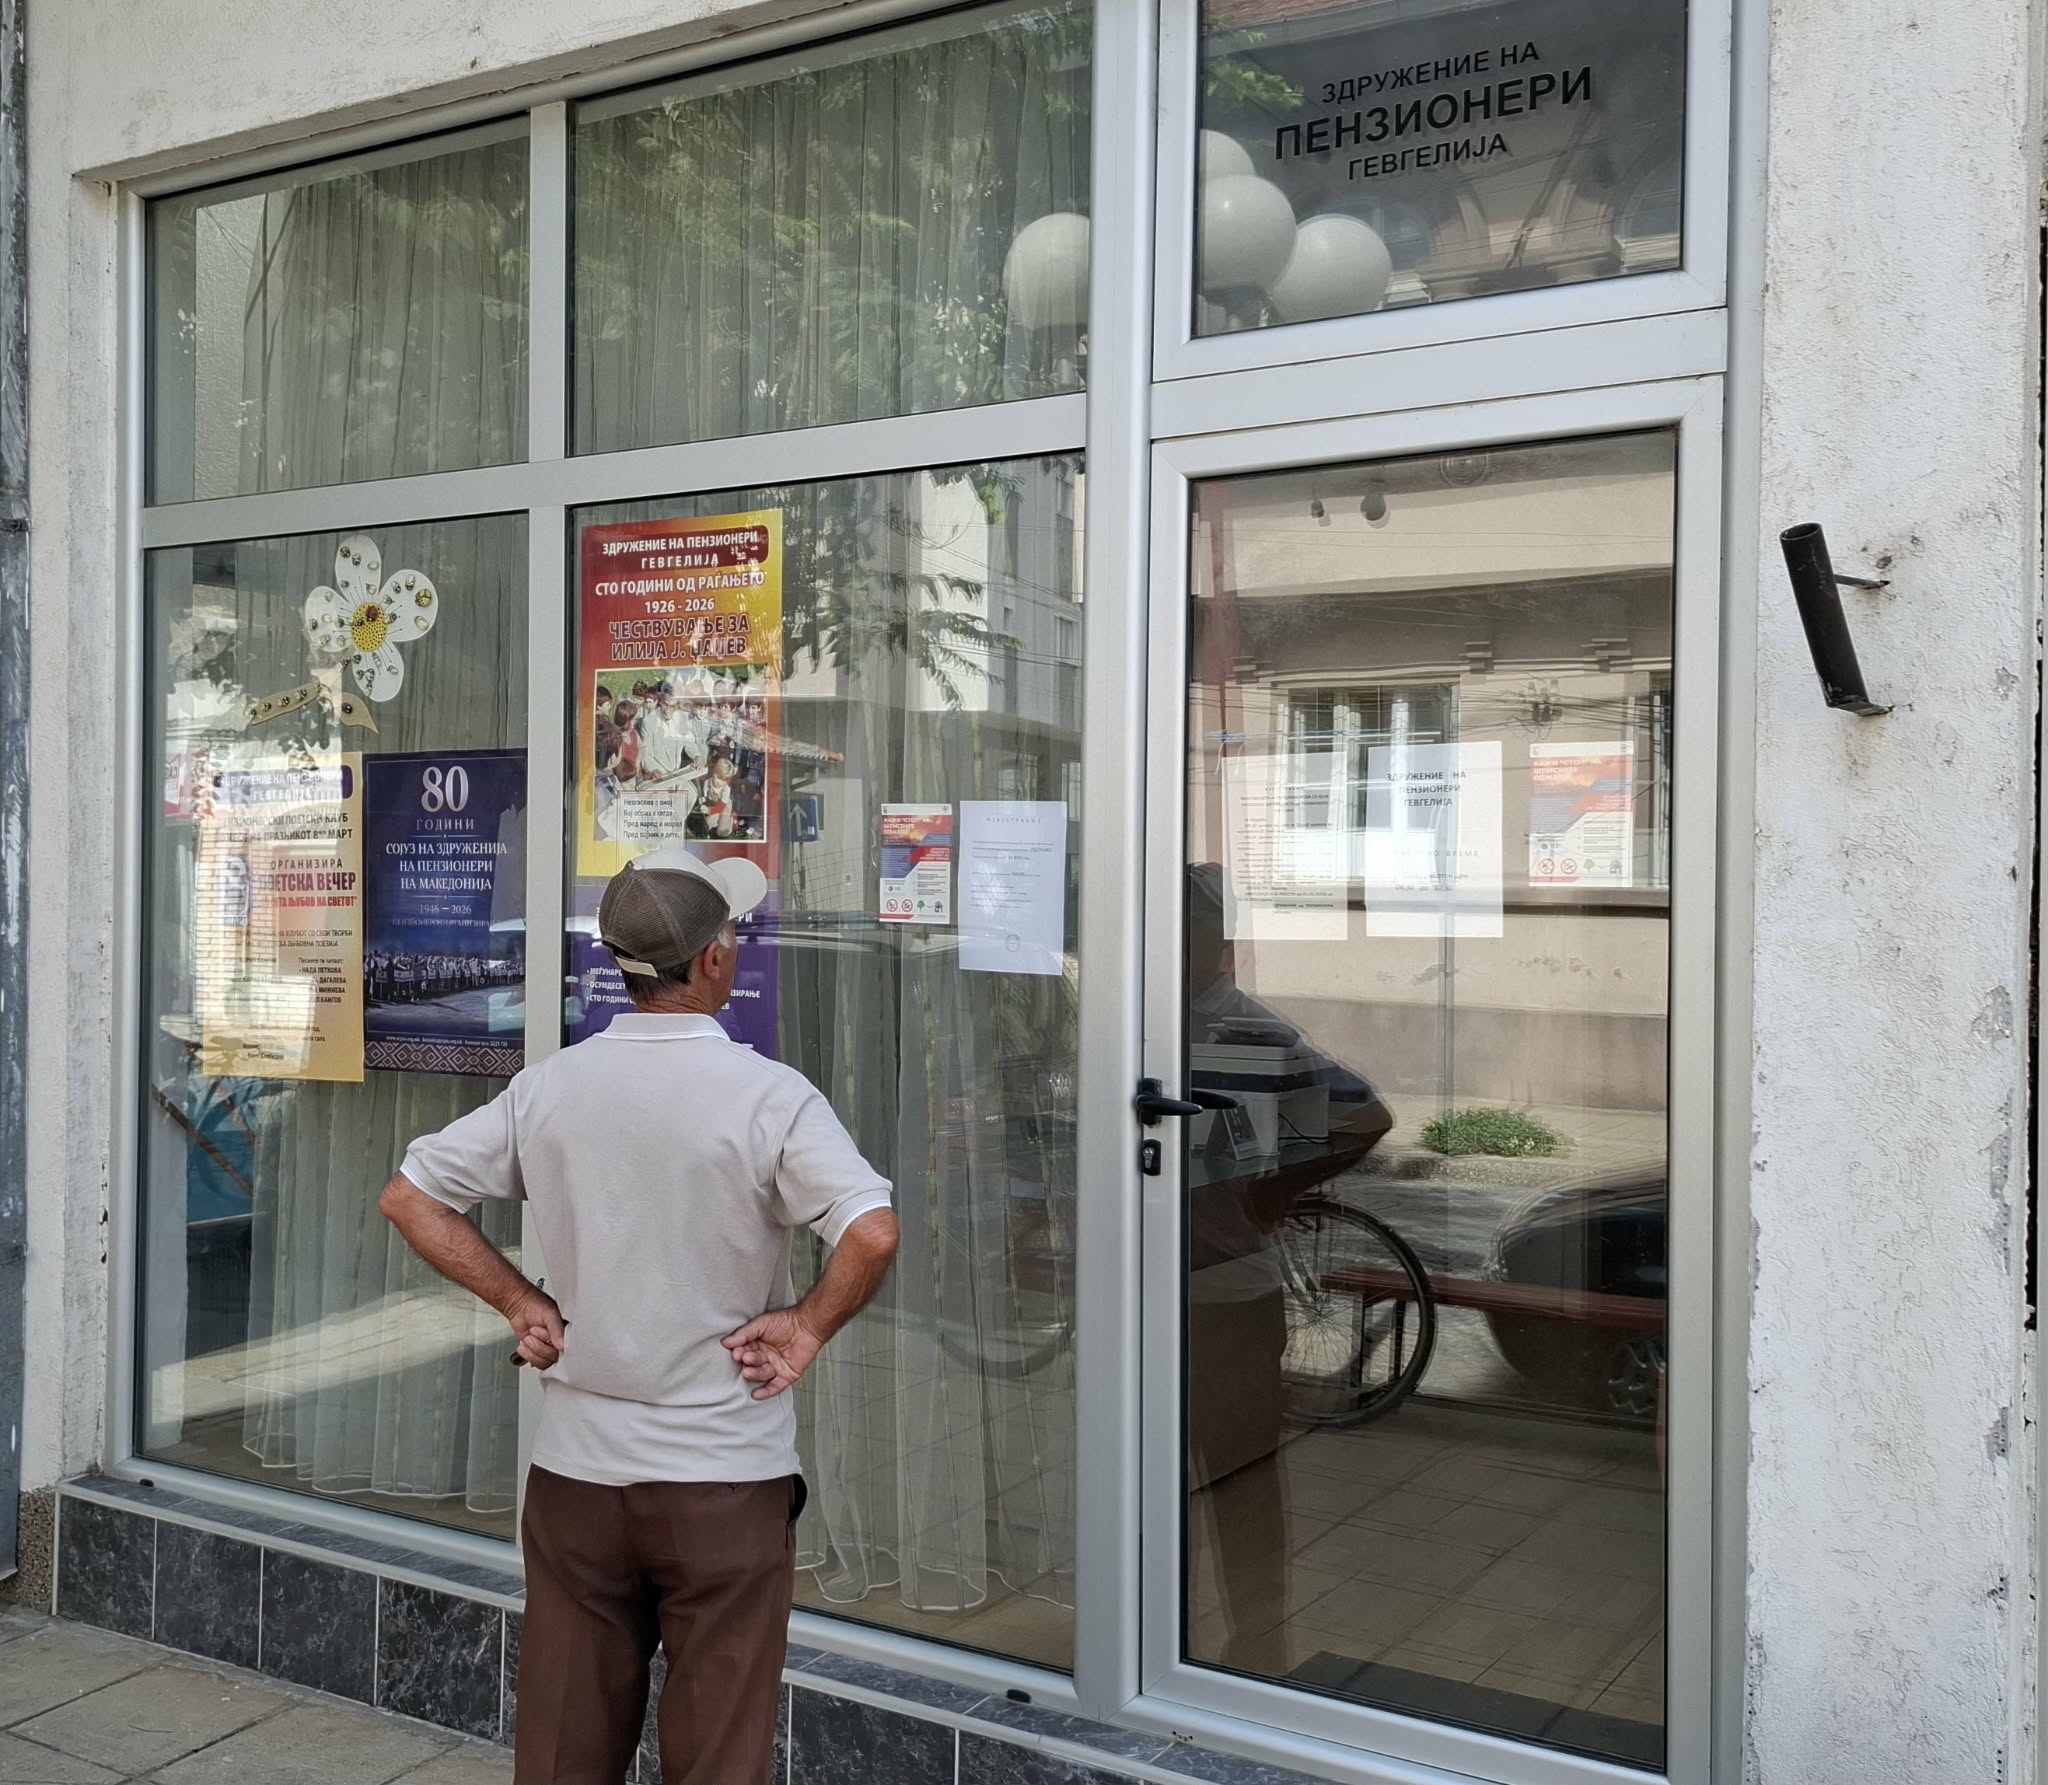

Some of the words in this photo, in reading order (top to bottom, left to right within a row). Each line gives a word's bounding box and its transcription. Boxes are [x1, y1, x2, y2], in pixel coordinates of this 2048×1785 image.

[1321, 50, 1491, 104] ЗДРУЖЕНИЕ
[1499, 41, 1540, 67] НА
[1274, 66, 1593, 160] ПЕНЗИОНЕРИ
[1348, 133, 1508, 180] ГЕВГЕЛИЈА
[602, 536, 667, 557] ЗДРУЖЕНИЕ
[669, 537, 685, 549] НА
[687, 531, 758, 548] ПЕНЗИОНЕРИ
[641, 553, 719, 570] ГЕВГЕЛИЈА
[595, 582, 619, 597] СТО
[621, 579, 673, 595] ГОДИНИ
[676, 578, 696, 593] ОД
[698, 571, 765, 590] РАЃАЊЕТО
[645, 600, 675, 614] 1926
[685, 598, 715, 612] 2026
[728, 613, 750, 633] ЗА
[612, 640, 667, 661] ИЛИЈА
[1453, 771, 1467, 779] НА
[421, 765, 469, 813] 80
[416, 818, 475, 832] ГОДИНИ
[328, 828, 353, 839] МАРТ
[386, 843, 416, 856] СОЈУЗ
[418, 843, 435, 855] НА
[436, 842, 508, 856] ЗДРУЖЕНИЈА
[271, 858, 343, 871] ОРГАНИЗИРА
[400, 860, 415, 872] НА
[418, 860, 493, 872] ПЕНЗИОНЕРИ
[264, 873, 314, 892] ЕТСКА
[317, 871, 356, 892] ВЕЧЕР
[401, 878, 417, 890] НА
[419, 877, 492, 891] МАКЕДОНИЈА
[451, 904, 472, 915] 2026
[590, 967, 622, 976] МЕЃУНАРО
[602, 995, 629, 1004] ГОДИНИ
